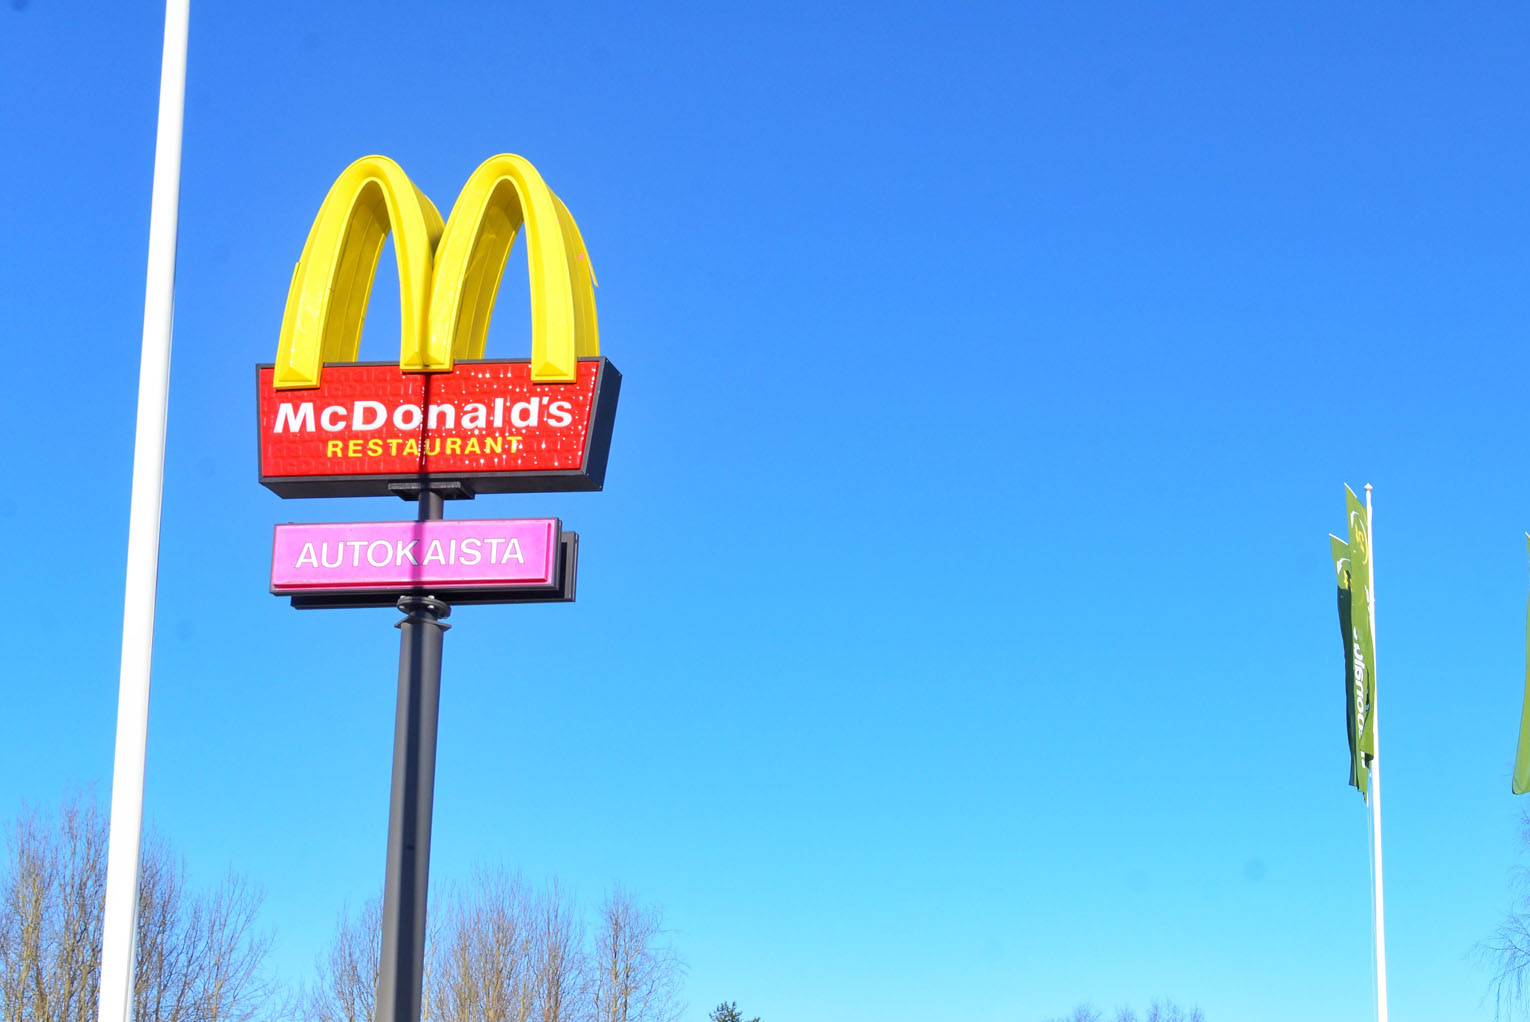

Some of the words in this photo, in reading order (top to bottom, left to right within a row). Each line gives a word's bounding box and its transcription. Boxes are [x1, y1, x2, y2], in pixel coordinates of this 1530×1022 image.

[273, 397, 573, 433] McDonald's
[327, 436, 523, 458] RESTAURANT
[295, 538, 525, 568] AUTOKAISTA
